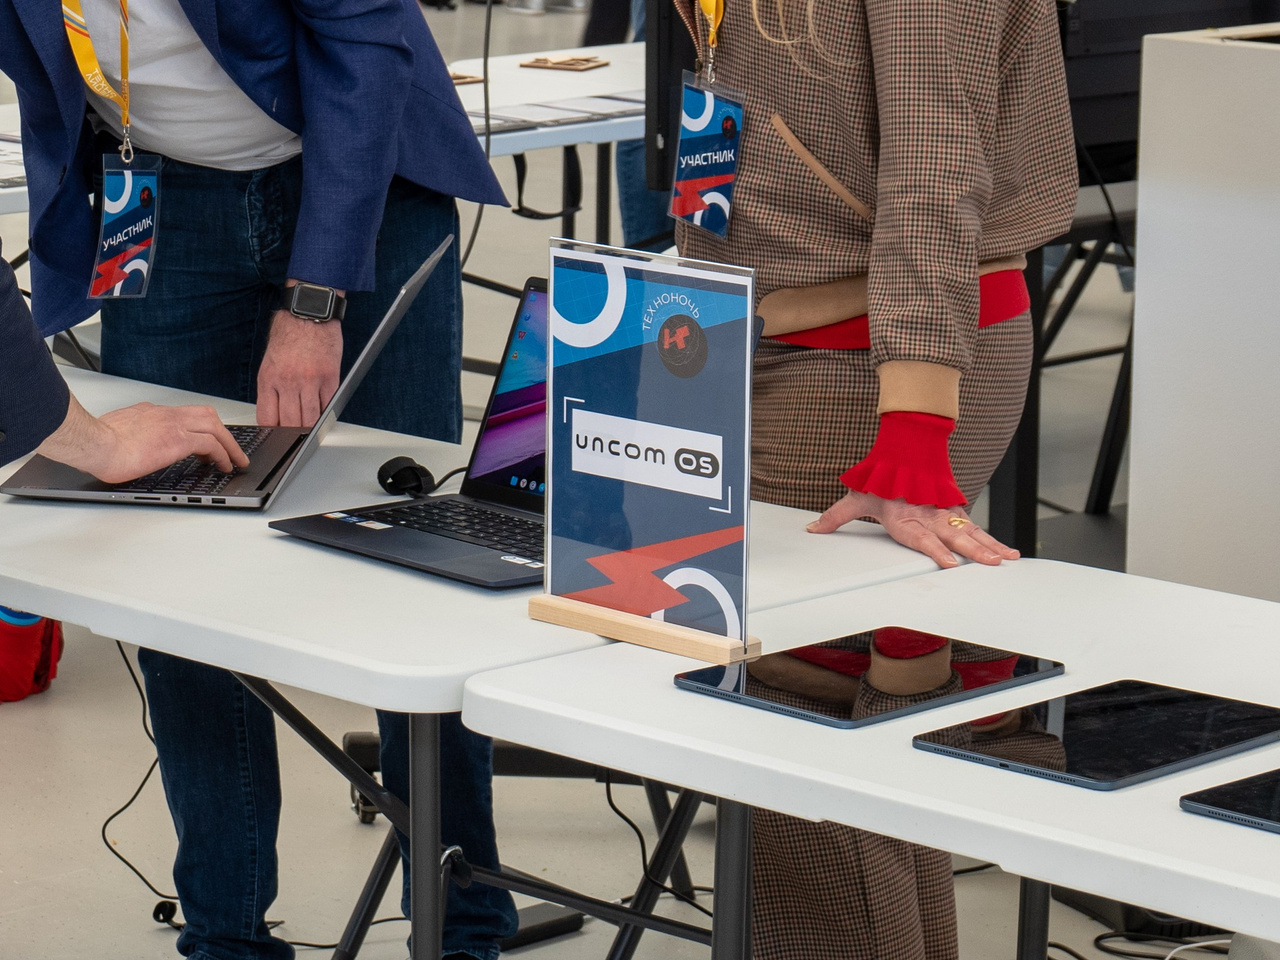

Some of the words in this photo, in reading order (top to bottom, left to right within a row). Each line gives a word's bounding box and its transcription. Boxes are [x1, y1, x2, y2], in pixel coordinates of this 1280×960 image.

[680, 148, 735, 169] УЧАСТНИК
[102, 215, 153, 252] УЧАСТНИК
[642, 292, 700, 331] ТЕХНОНОЧЬ
[575, 433, 666, 465] uncom
[678, 453, 713, 474] OS
